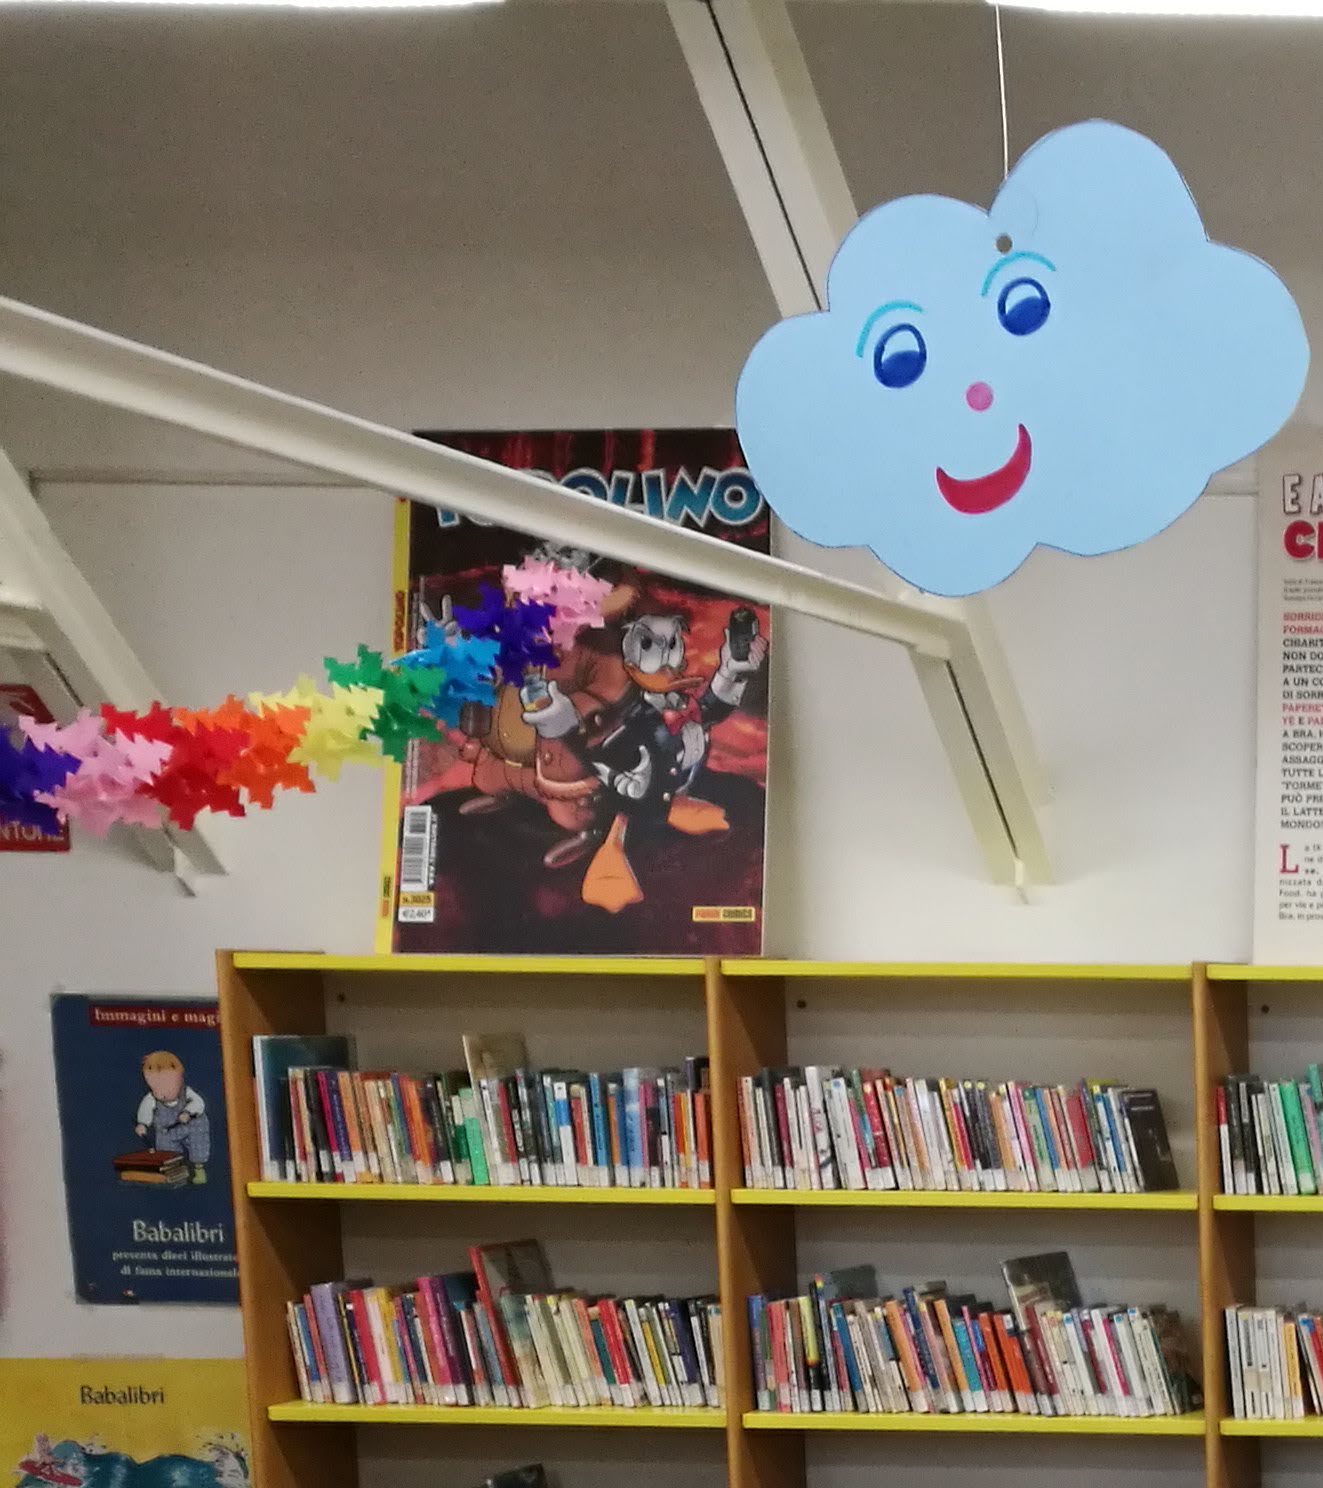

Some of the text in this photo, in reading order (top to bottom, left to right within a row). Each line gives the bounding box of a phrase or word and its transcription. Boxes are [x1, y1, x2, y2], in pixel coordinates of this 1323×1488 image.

[1283, 474, 1302, 514] E
[1283, 651, 1306, 661] NON
[1283, 678, 1290, 687] A
[1293, 678, 1309, 687] UN
[1282, 690, 1293, 700] DI
[1298, 717, 1305, 726] E
[1282, 730, 1289, 739] A
[1282, 768, 1314, 777] TUTTE
[1281, 807, 1290, 816] IL
[1281, 820, 1323, 829] MONDO!
[1280, 844, 1299, 874] L
[94, 1008, 179, 1026] Immagini e
[132, 1218, 225, 1244] Babalibri
[112, 1252, 158, 1261] presenta
[120, 1264, 131, 1276] di
[135, 1265, 162, 1276] fama
[79, 1383, 166, 1406] Babalibri
